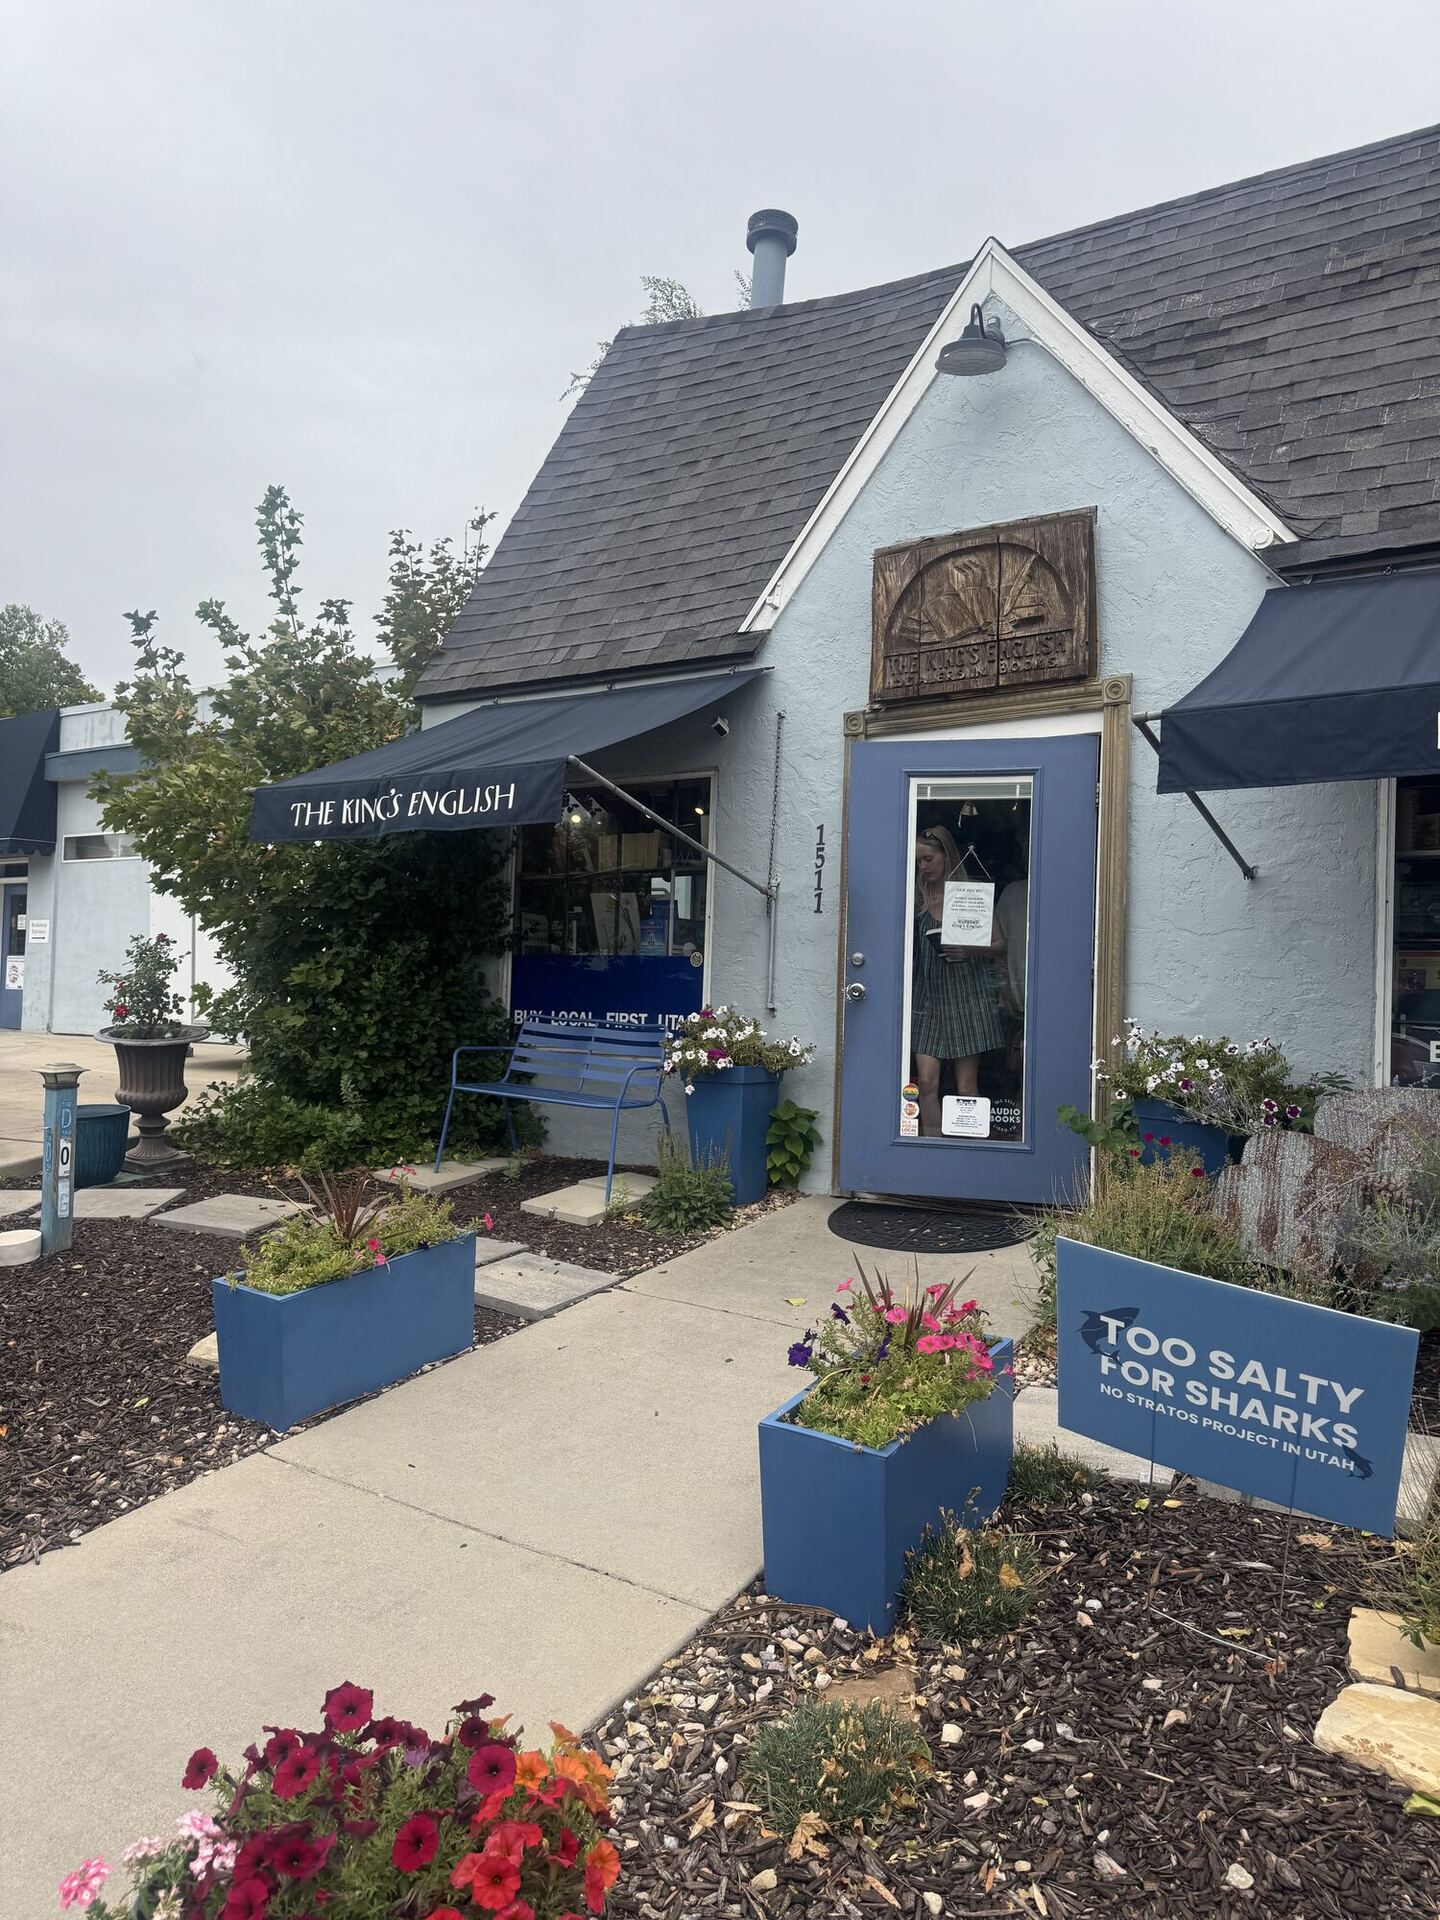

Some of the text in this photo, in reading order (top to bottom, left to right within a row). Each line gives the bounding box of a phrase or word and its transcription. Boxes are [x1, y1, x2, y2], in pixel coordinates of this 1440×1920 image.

[889, 655, 918, 677] THE
[987, 634, 1067, 663] ENGLISH
[1000, 656, 1058, 675] BOOKS
[290, 783, 516, 827] THE KING'S ENGLISH
[813, 823, 826, 914] 1511
[513, 1009, 690, 1031] BUY LOCAL FIRST UTA
[990, 1107, 1021, 1116] AUDIO
[1100, 1315, 1365, 1415] TOO SALTY
[1100, 1354, 1359, 1450] FOR SHARKS
[1100, 1383, 1356, 1472] NO STRATOS PROJECT IN UTAH
